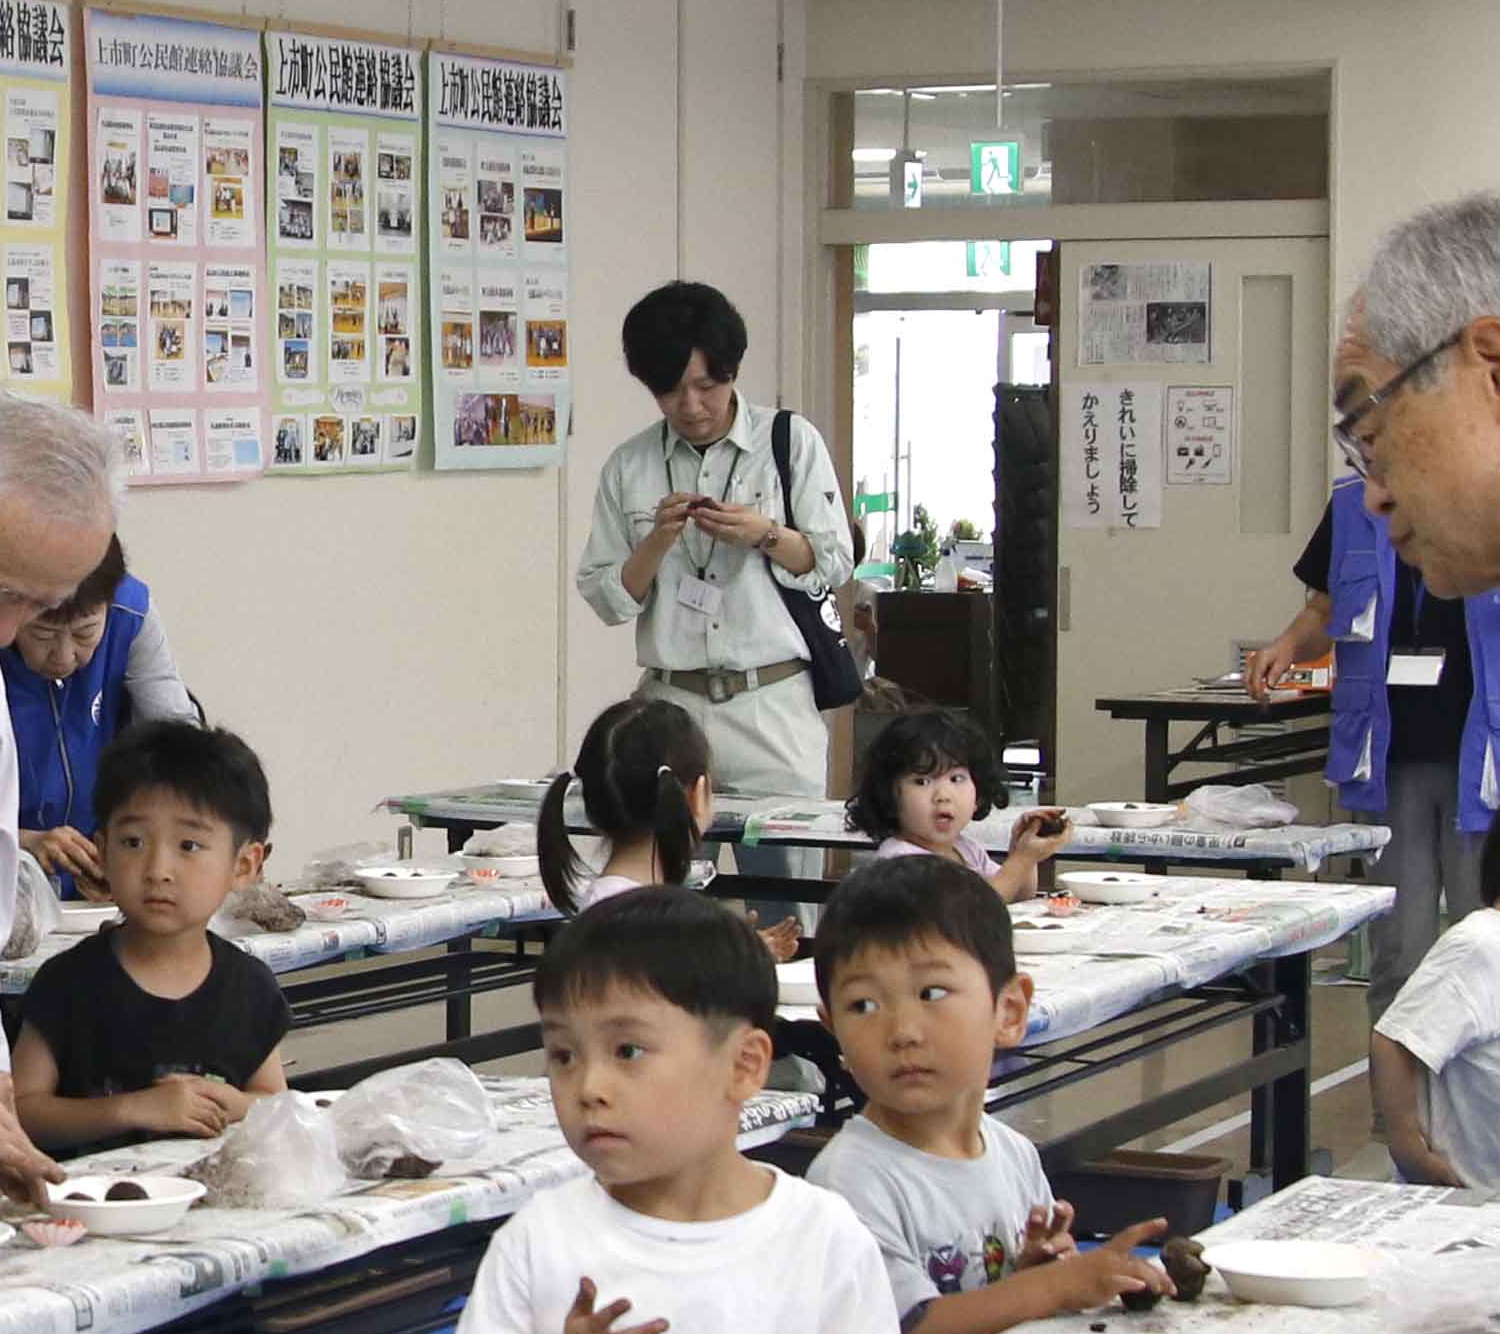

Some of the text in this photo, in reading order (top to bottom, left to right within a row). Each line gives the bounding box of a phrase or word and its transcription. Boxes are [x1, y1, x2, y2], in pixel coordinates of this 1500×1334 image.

[97, 37, 259, 81] 上市町公民館連絡協議会
[276, 38, 415, 112] 上市町公民館連絡協議会
[438, 62, 562, 131] 上市町公民館連絡協議会
[1082, 392, 1101, 515] かえりましょう
[1117, 388, 1138, 528] きれいに掃除して
